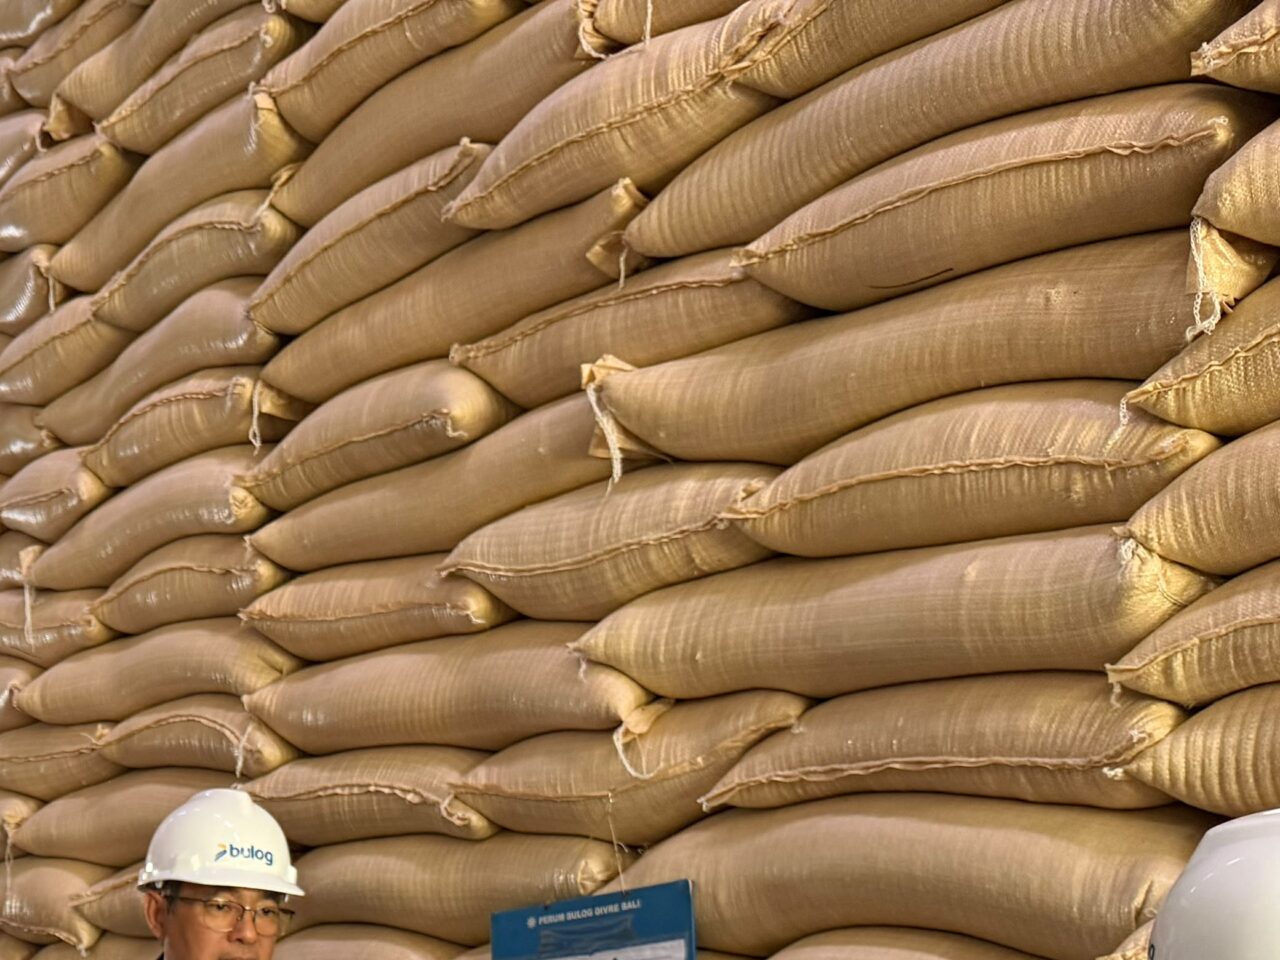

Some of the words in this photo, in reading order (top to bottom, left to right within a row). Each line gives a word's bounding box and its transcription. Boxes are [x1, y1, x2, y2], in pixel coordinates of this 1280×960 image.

[229, 844, 273, 866] bulog
[538, 913, 565, 926] PERUM
[566, 907, 594, 921] BULOG
[595, 903, 620, 917] DIVRE
[621, 899, 641, 911] BALI
